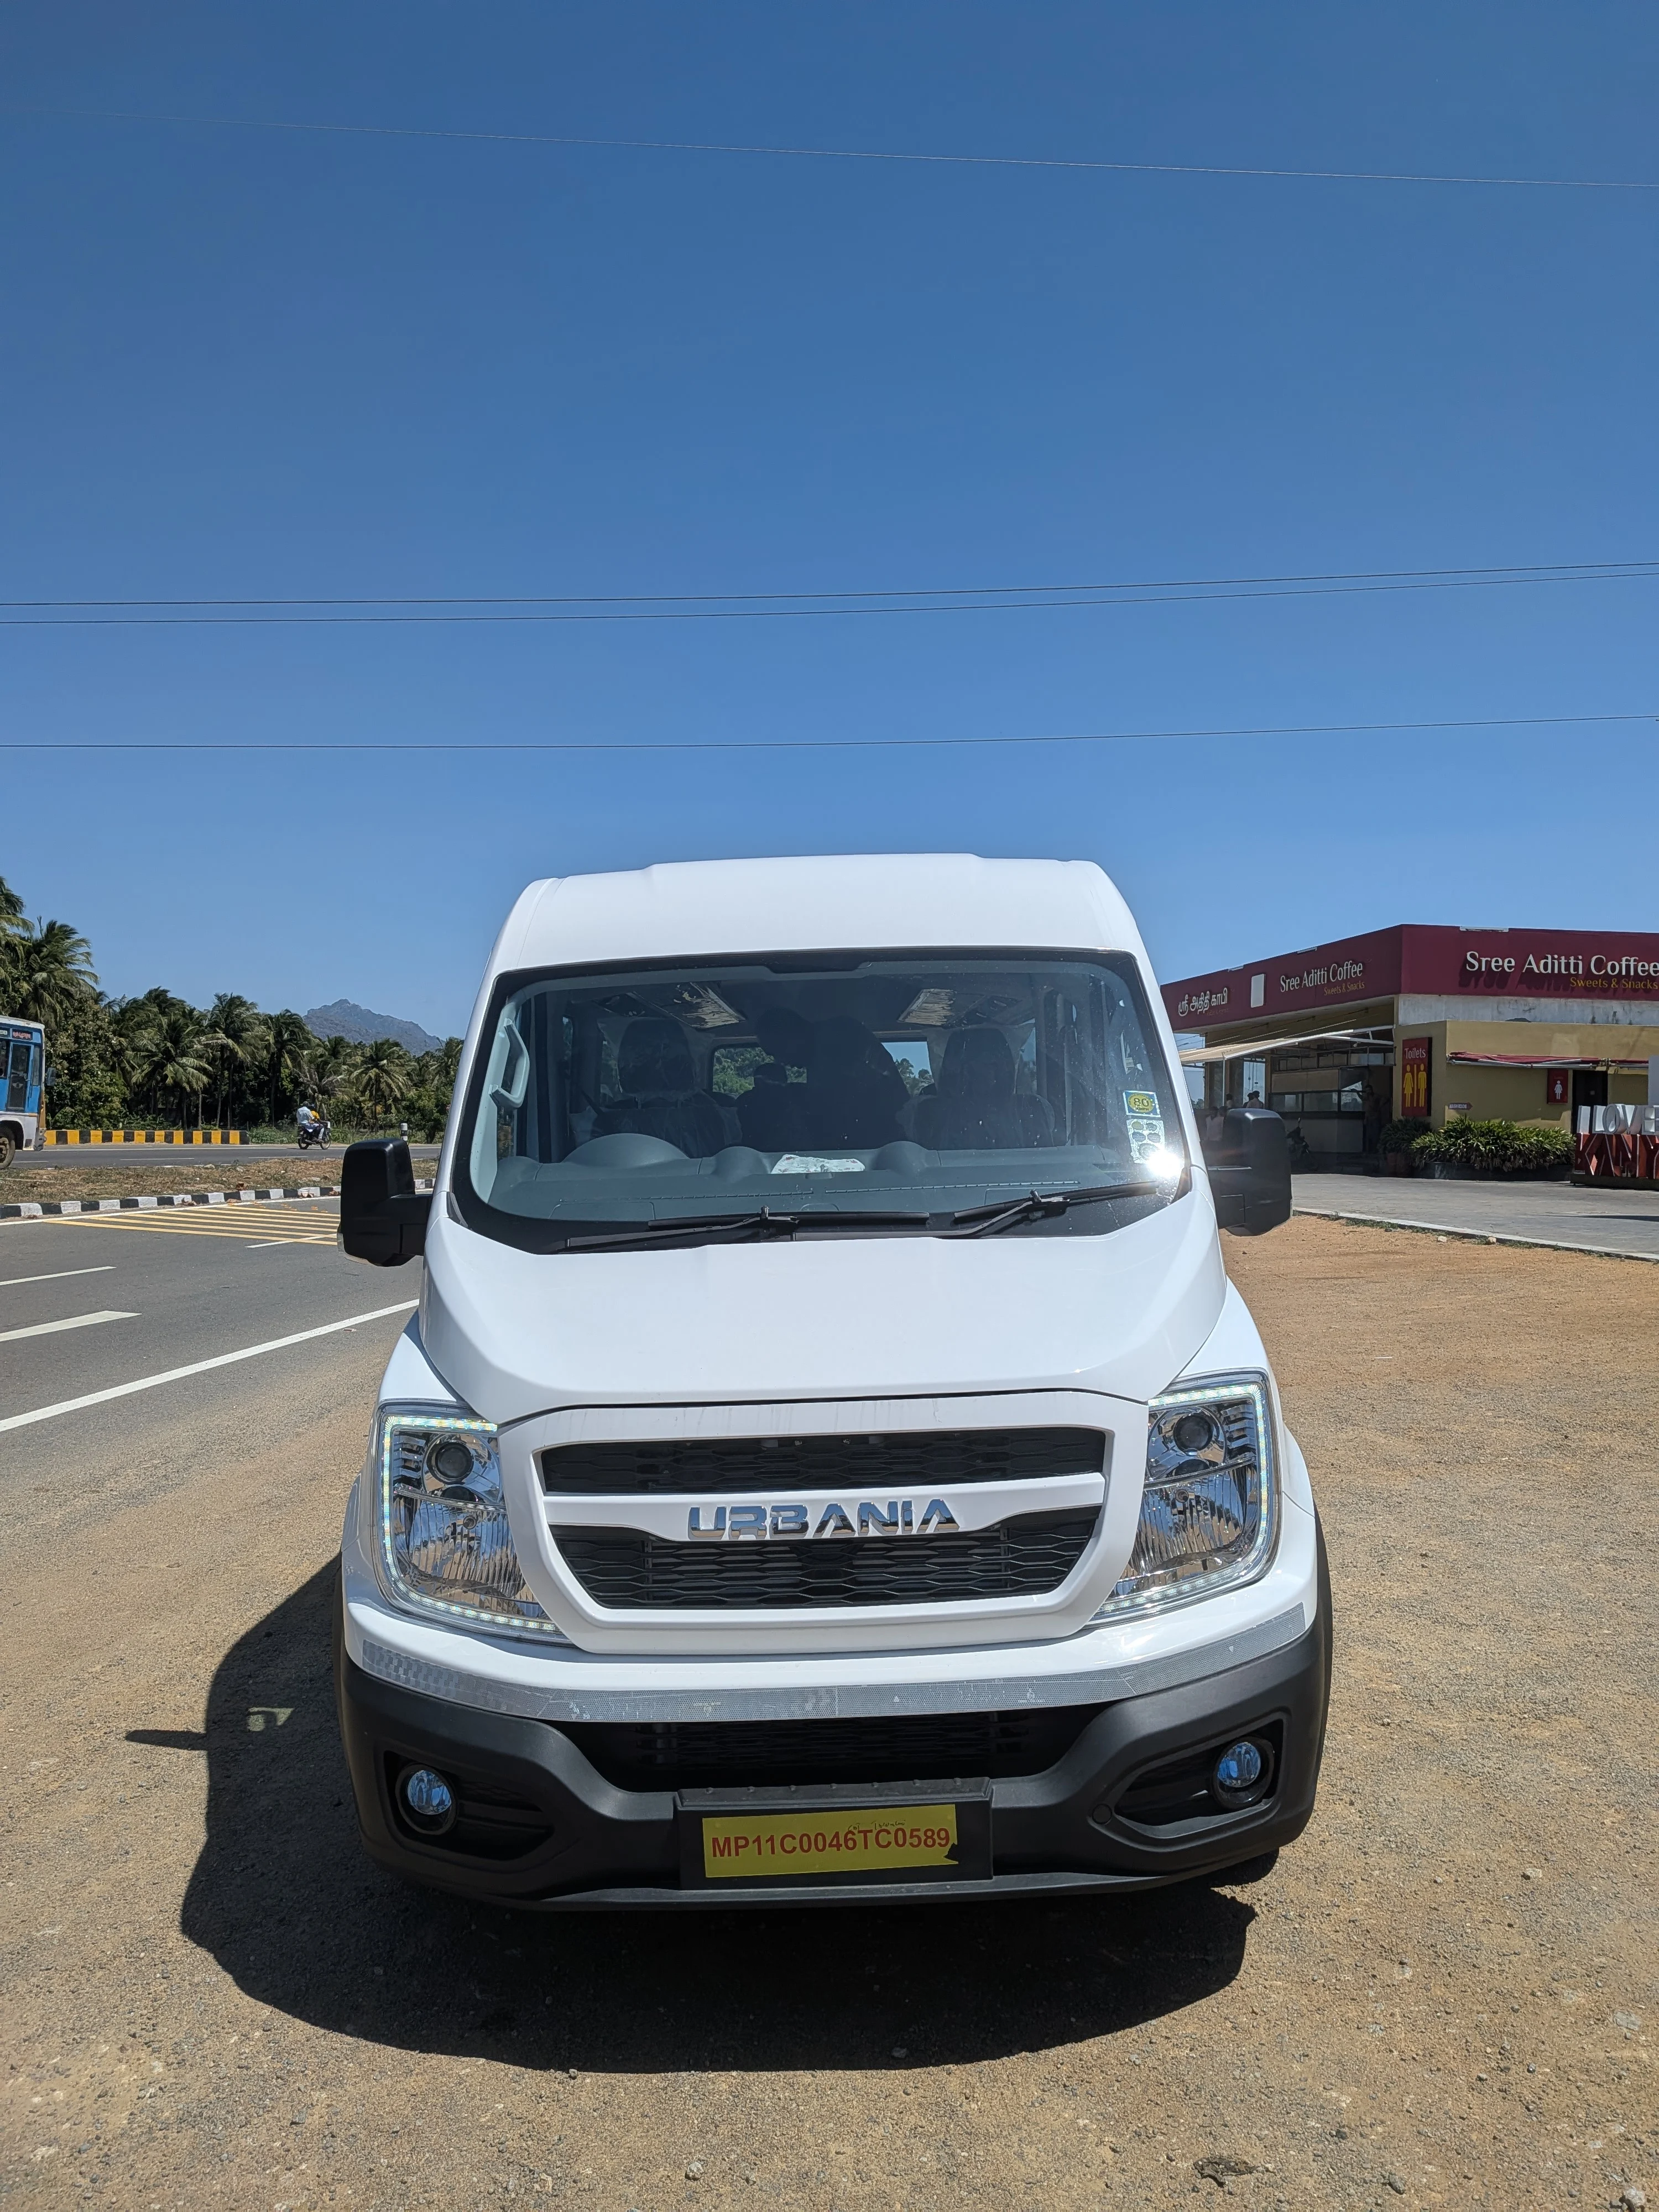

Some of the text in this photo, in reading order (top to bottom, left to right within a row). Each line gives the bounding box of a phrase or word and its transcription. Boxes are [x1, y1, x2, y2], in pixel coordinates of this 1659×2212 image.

[1466, 951, 1659, 977] Sree Aditti Coffee
[1280, 960, 1363, 993] Sree Aditti Coffee
[1570, 977, 1658, 990] Sweets & Snacks
[1211, 987, 1228, 1006] காபி
[1324, 980, 1365, 996] Sweets & Snacks
[1405, 1047, 1426, 1060] Toilets
[1134, 1098, 1149, 1107] 80
[688, 1498, 960, 1540] URBANIA
[712, 1828, 950, 1858] MP11C0046TC0589
